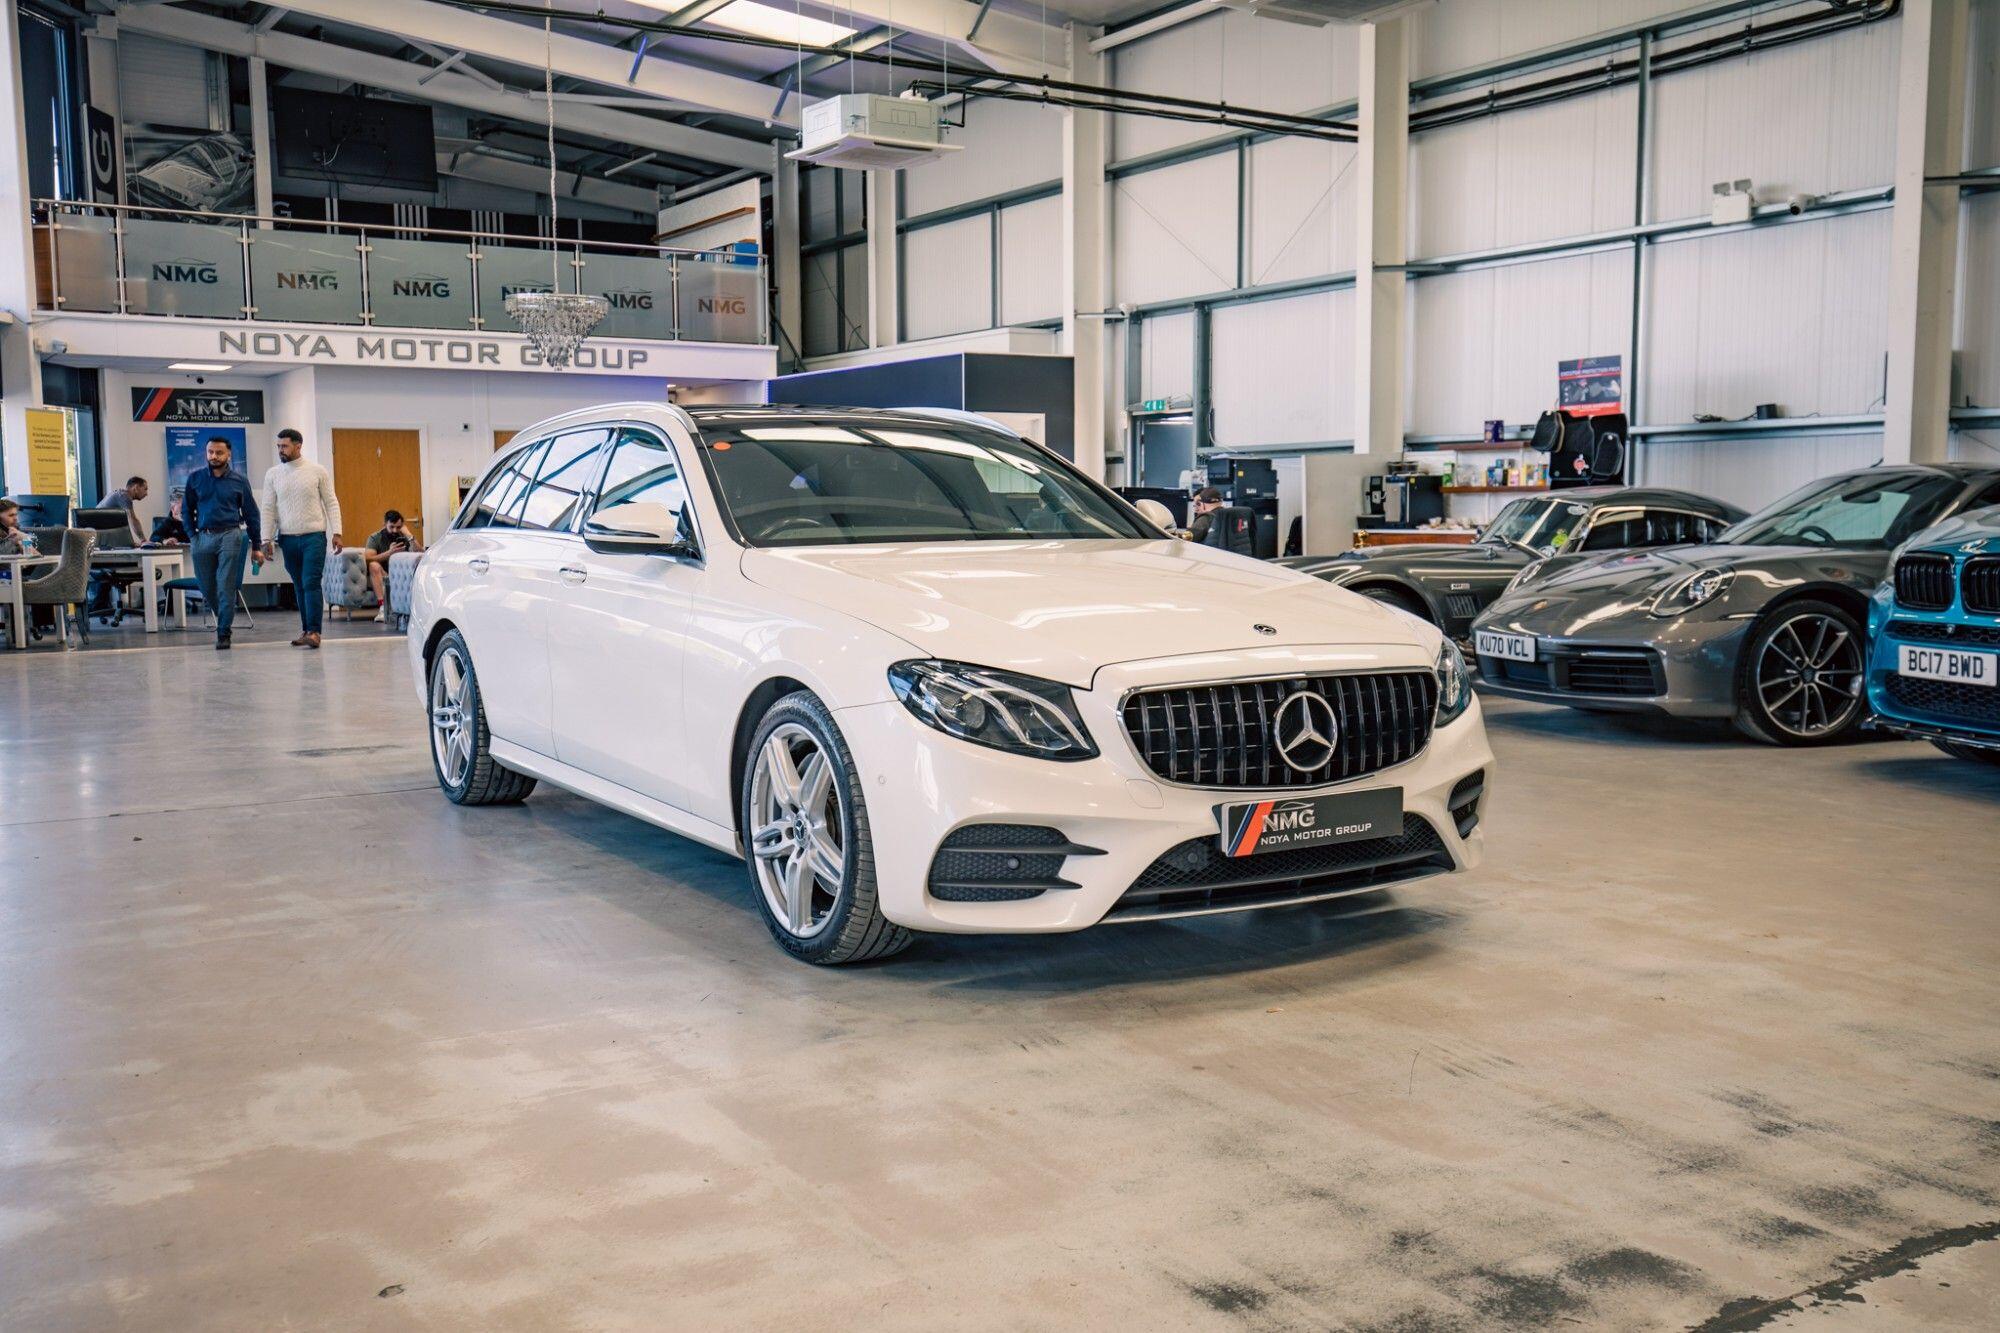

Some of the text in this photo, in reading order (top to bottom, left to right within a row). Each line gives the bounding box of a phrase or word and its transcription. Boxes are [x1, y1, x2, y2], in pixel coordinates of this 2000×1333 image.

[152, 263, 218, 284] NMG
[276, 272, 338, 290] NMG
[393, 280, 450, 298] NMG
[602, 292, 653, 310] NMG
[698, 298, 746, 314] NMG
[219, 331, 648, 369] NOYA MOTOR GOUP
[176, 399, 239, 416] NMG
[1480, 634, 1529, 657] KU70 VCL
[1908, 649, 1984, 679] BC17 BWD
[1261, 808, 1316, 833] NMG
[1261, 822, 1373, 846] NOYA MOTOR GROUP
